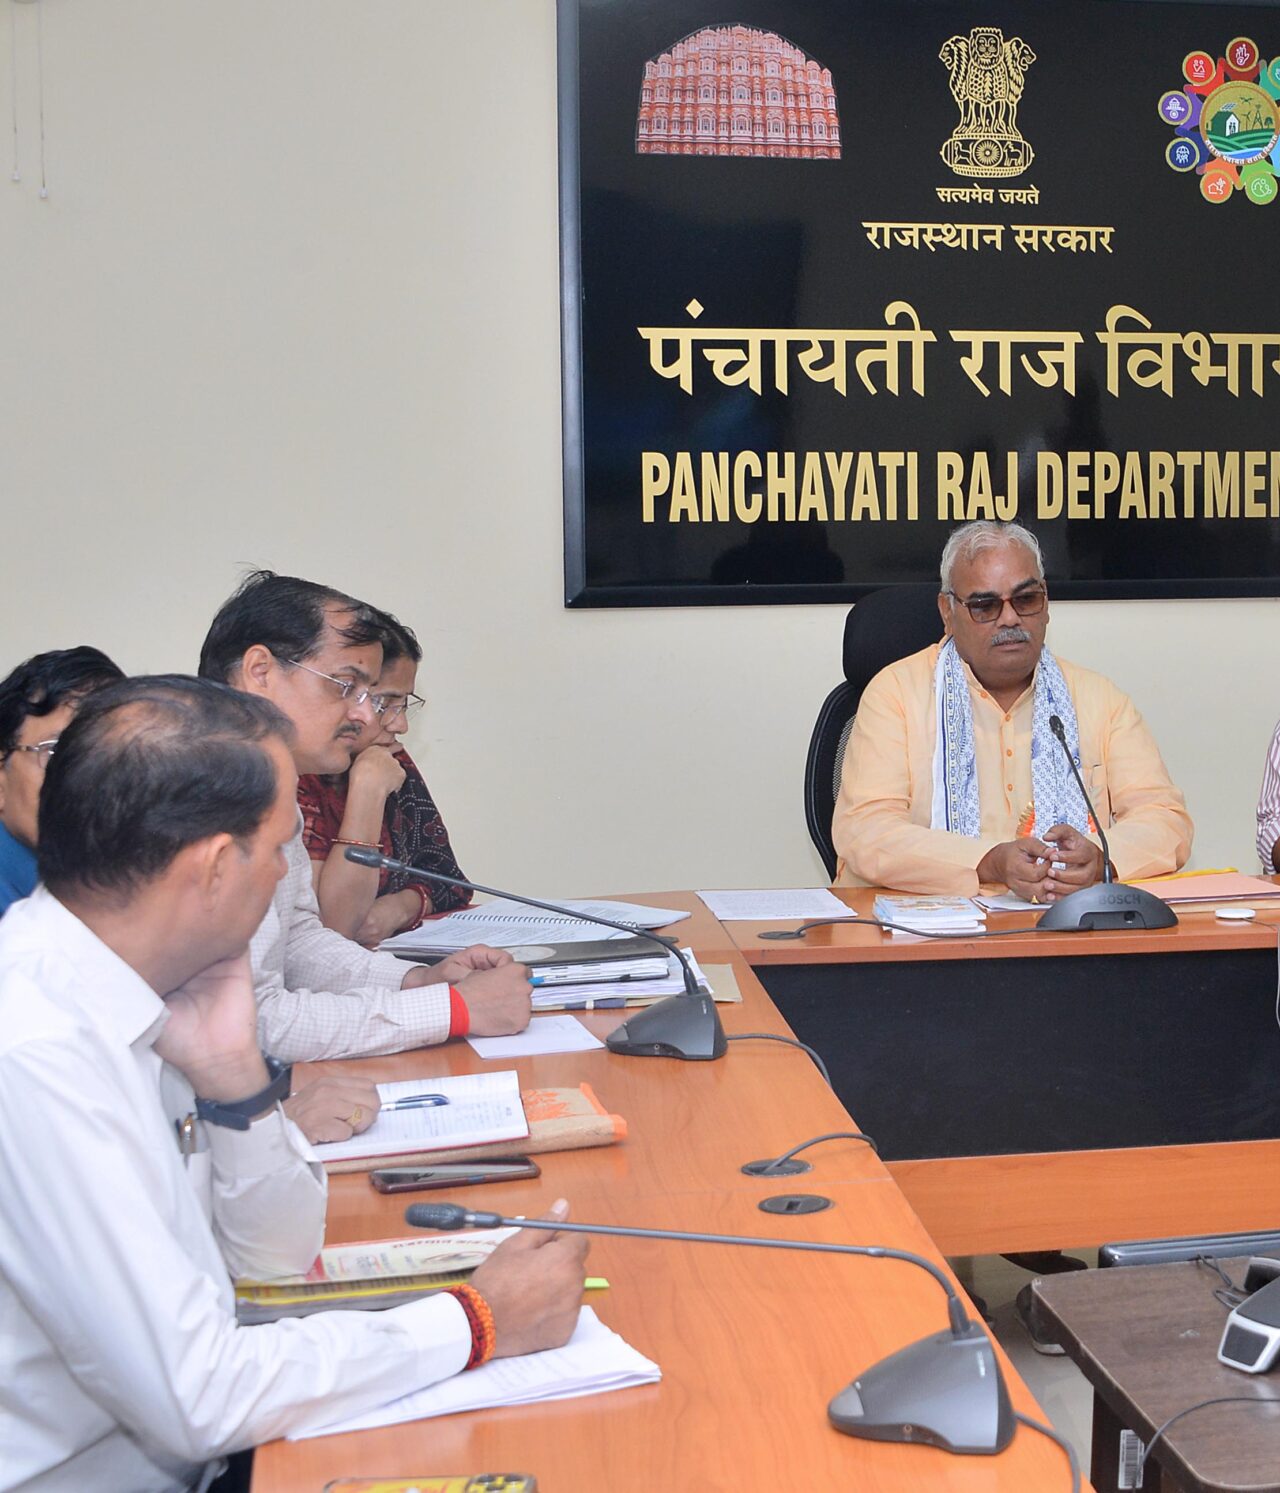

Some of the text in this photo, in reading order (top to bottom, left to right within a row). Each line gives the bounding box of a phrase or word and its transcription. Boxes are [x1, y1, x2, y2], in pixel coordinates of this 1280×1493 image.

[936, 183, 1040, 204] सत्यमेव जयते
[861, 222, 1115, 253] राजस्थान सरकार
[637, 299, 937, 397] पंचायती
[949, 330, 1084, 397] राज
[641, 450, 919, 524] PANCHAYATI
[937, 451, 1019, 521] RAJ
[1098, 893, 1141, 905] BOSCH
